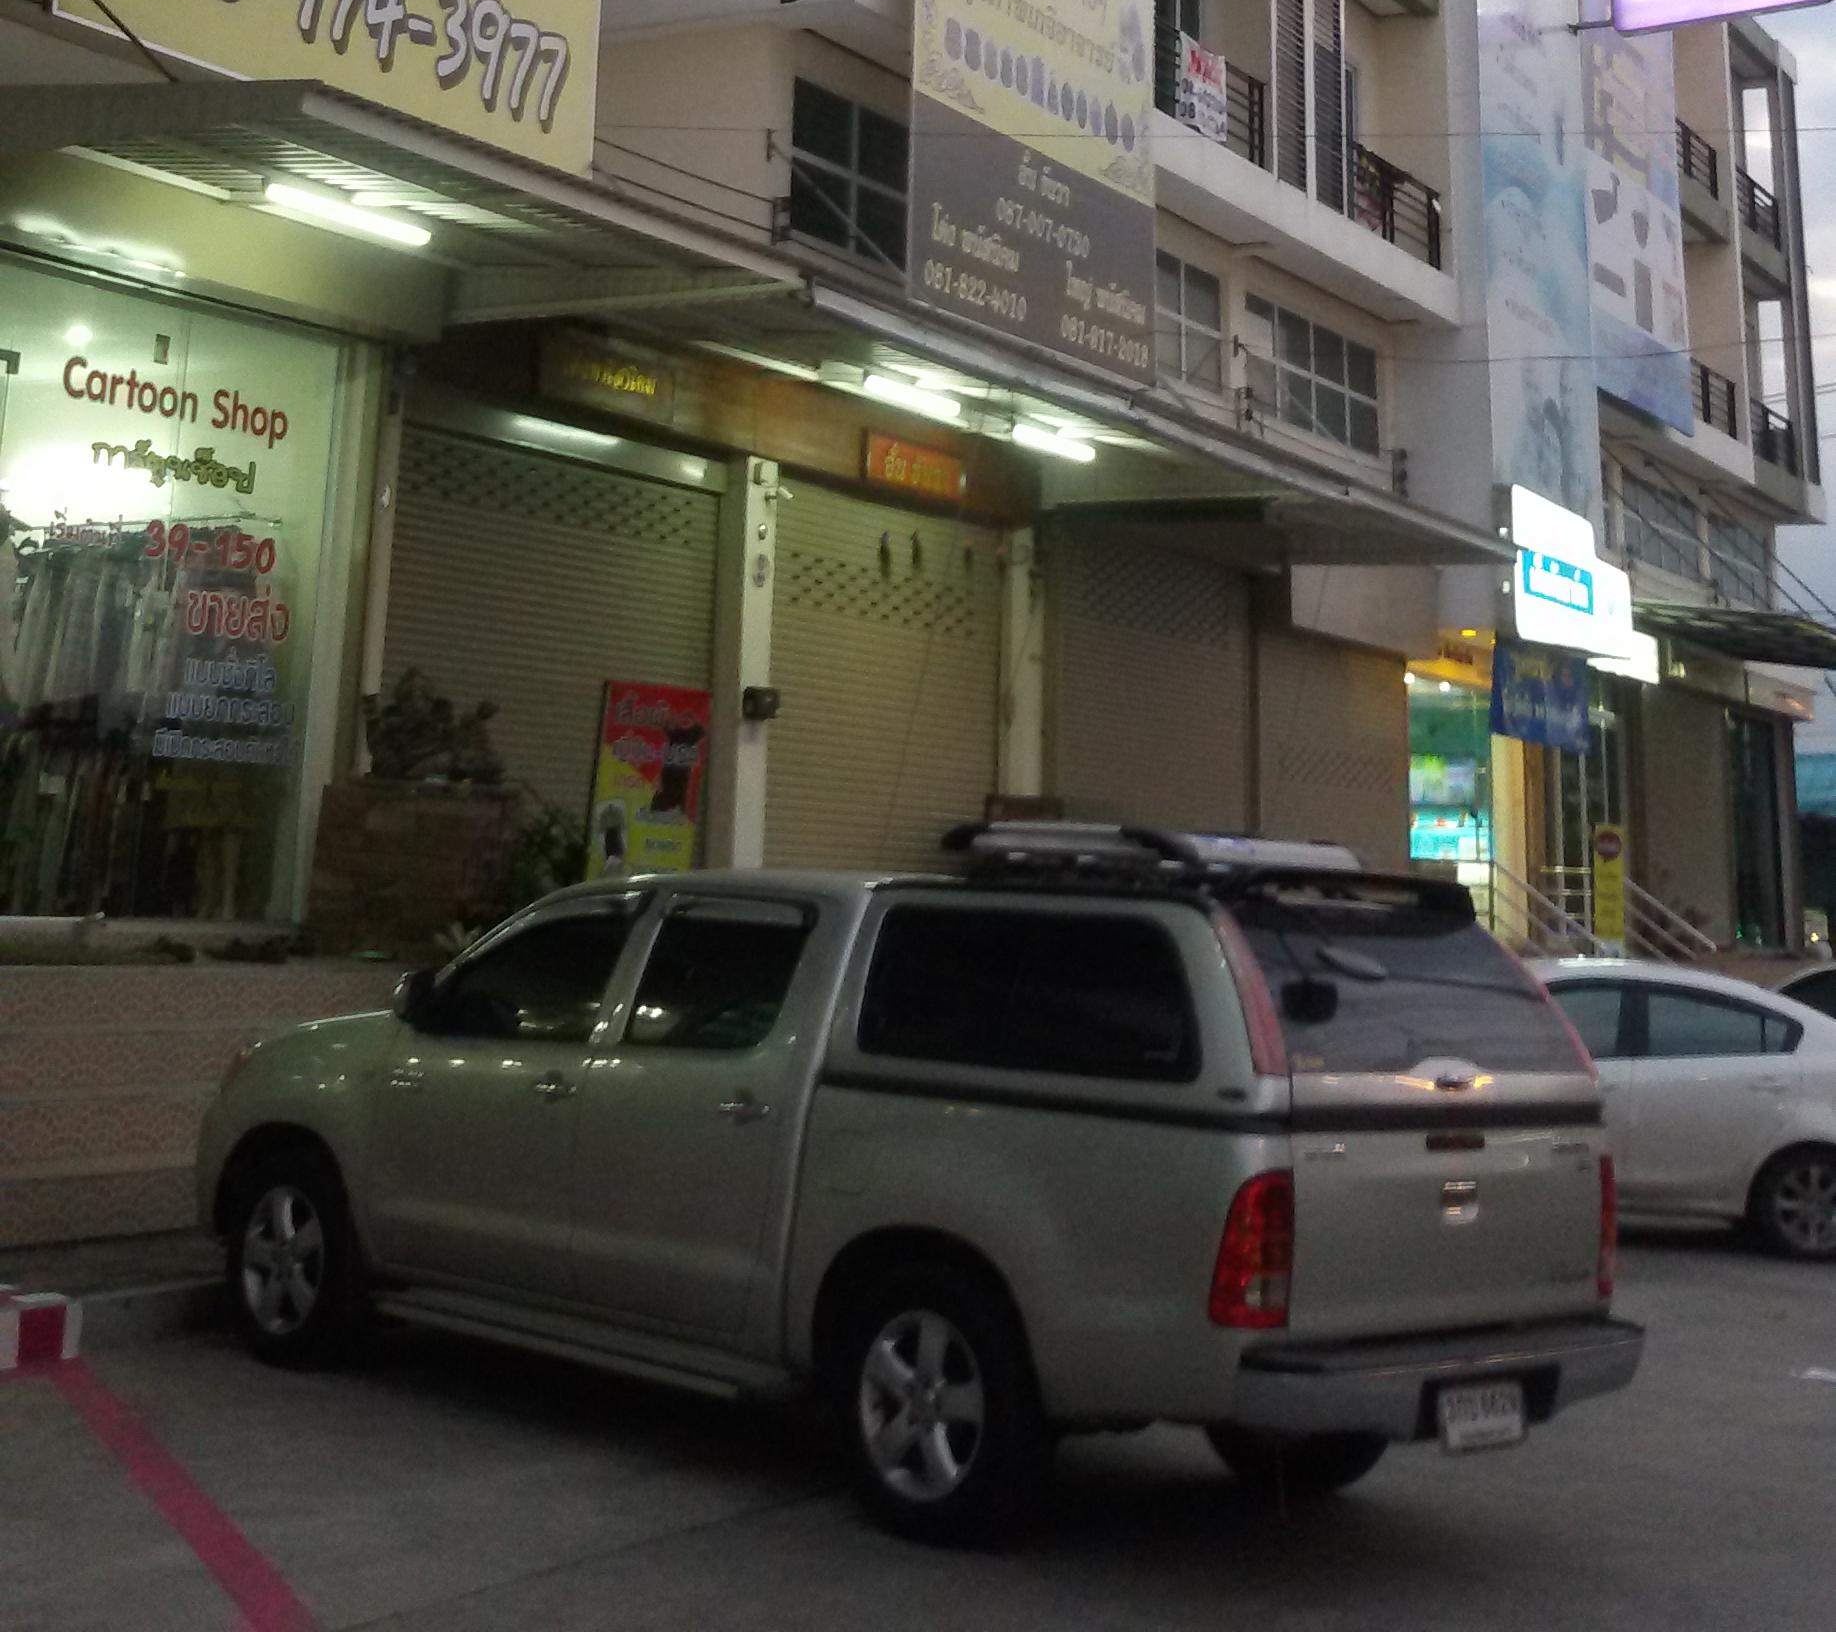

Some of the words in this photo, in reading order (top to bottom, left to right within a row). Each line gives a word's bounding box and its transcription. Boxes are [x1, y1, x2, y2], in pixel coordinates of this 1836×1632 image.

[63, 356, 198, 423] Cartoon
[212, 389, 288, 449] Shop
[144, 519, 276, 574] 39-150
[186, 584, 291, 643] ขายส่ง
